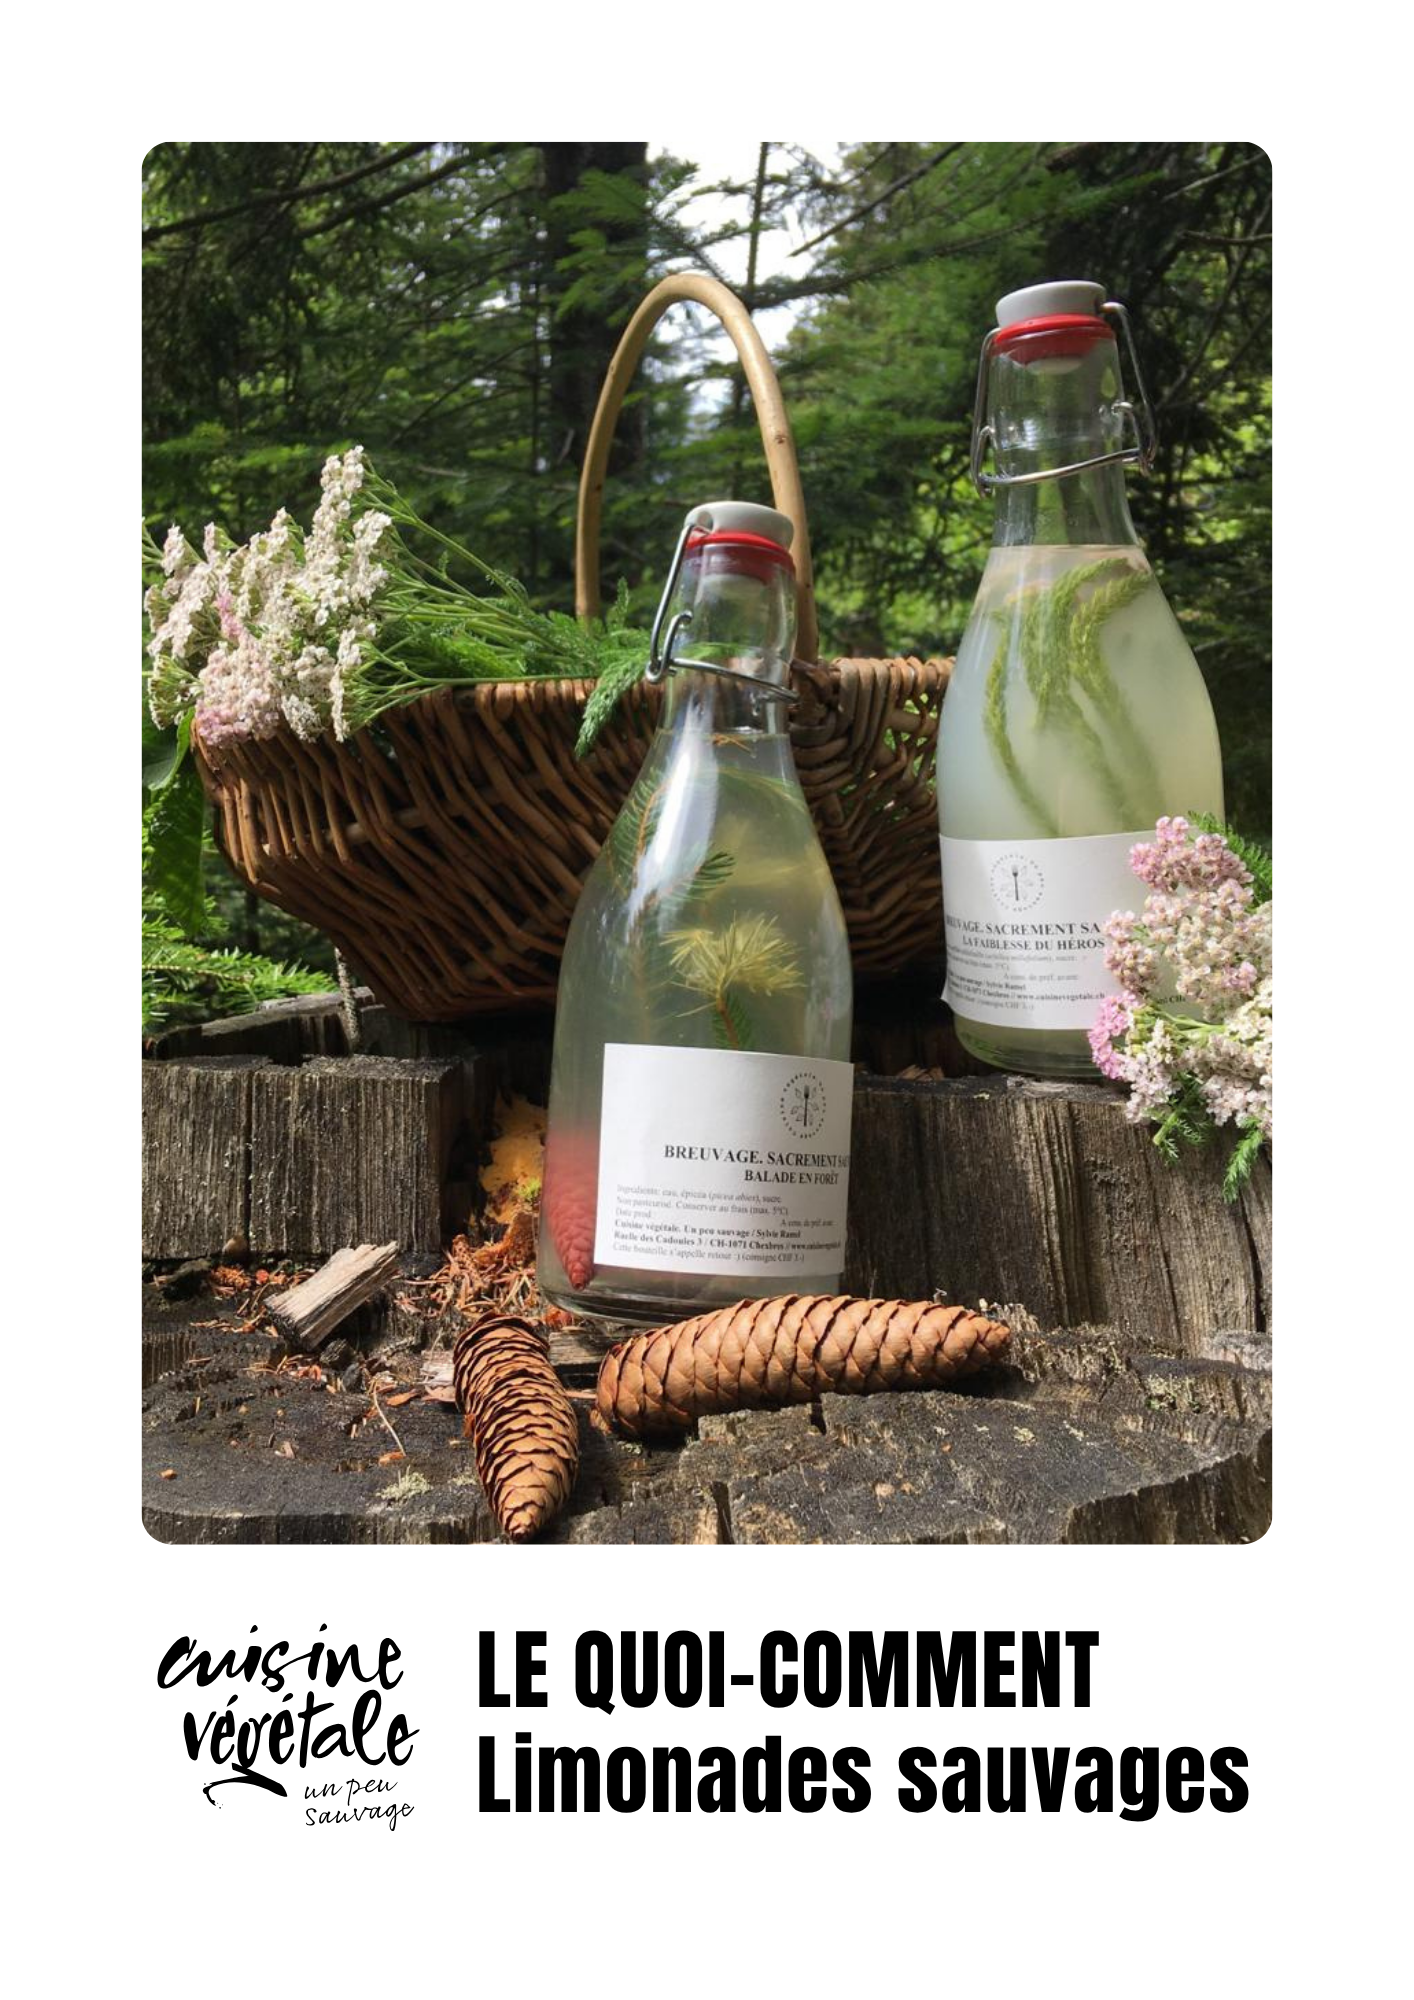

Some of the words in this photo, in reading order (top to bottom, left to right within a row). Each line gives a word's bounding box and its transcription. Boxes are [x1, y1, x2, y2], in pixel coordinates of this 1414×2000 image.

[985, 922, 1077, 936] SACREMENT
[974, 937, 1032, 951] FAIBLESSE
[1035, 940, 1054, 951] DU
[1057, 935, 1106, 951] HÉROS
[664, 1144, 764, 1165] BREUVAGE.
[766, 1151, 837, 1169] SACREMENT
[744, 1169, 797, 1184] BALADE
[799, 1171, 813, 1184] EN
[814, 1169, 839, 1186] FORÊT
[683, 1224, 697, 1234] Un
[699, 1227, 714, 1236] peu
[716, 1228, 750, 1239] sauvage
[756, 1229, 779, 1240] Sylvie
[640, 1233, 654, 1243] des
[709, 1239, 747, 1250] CH-1071
